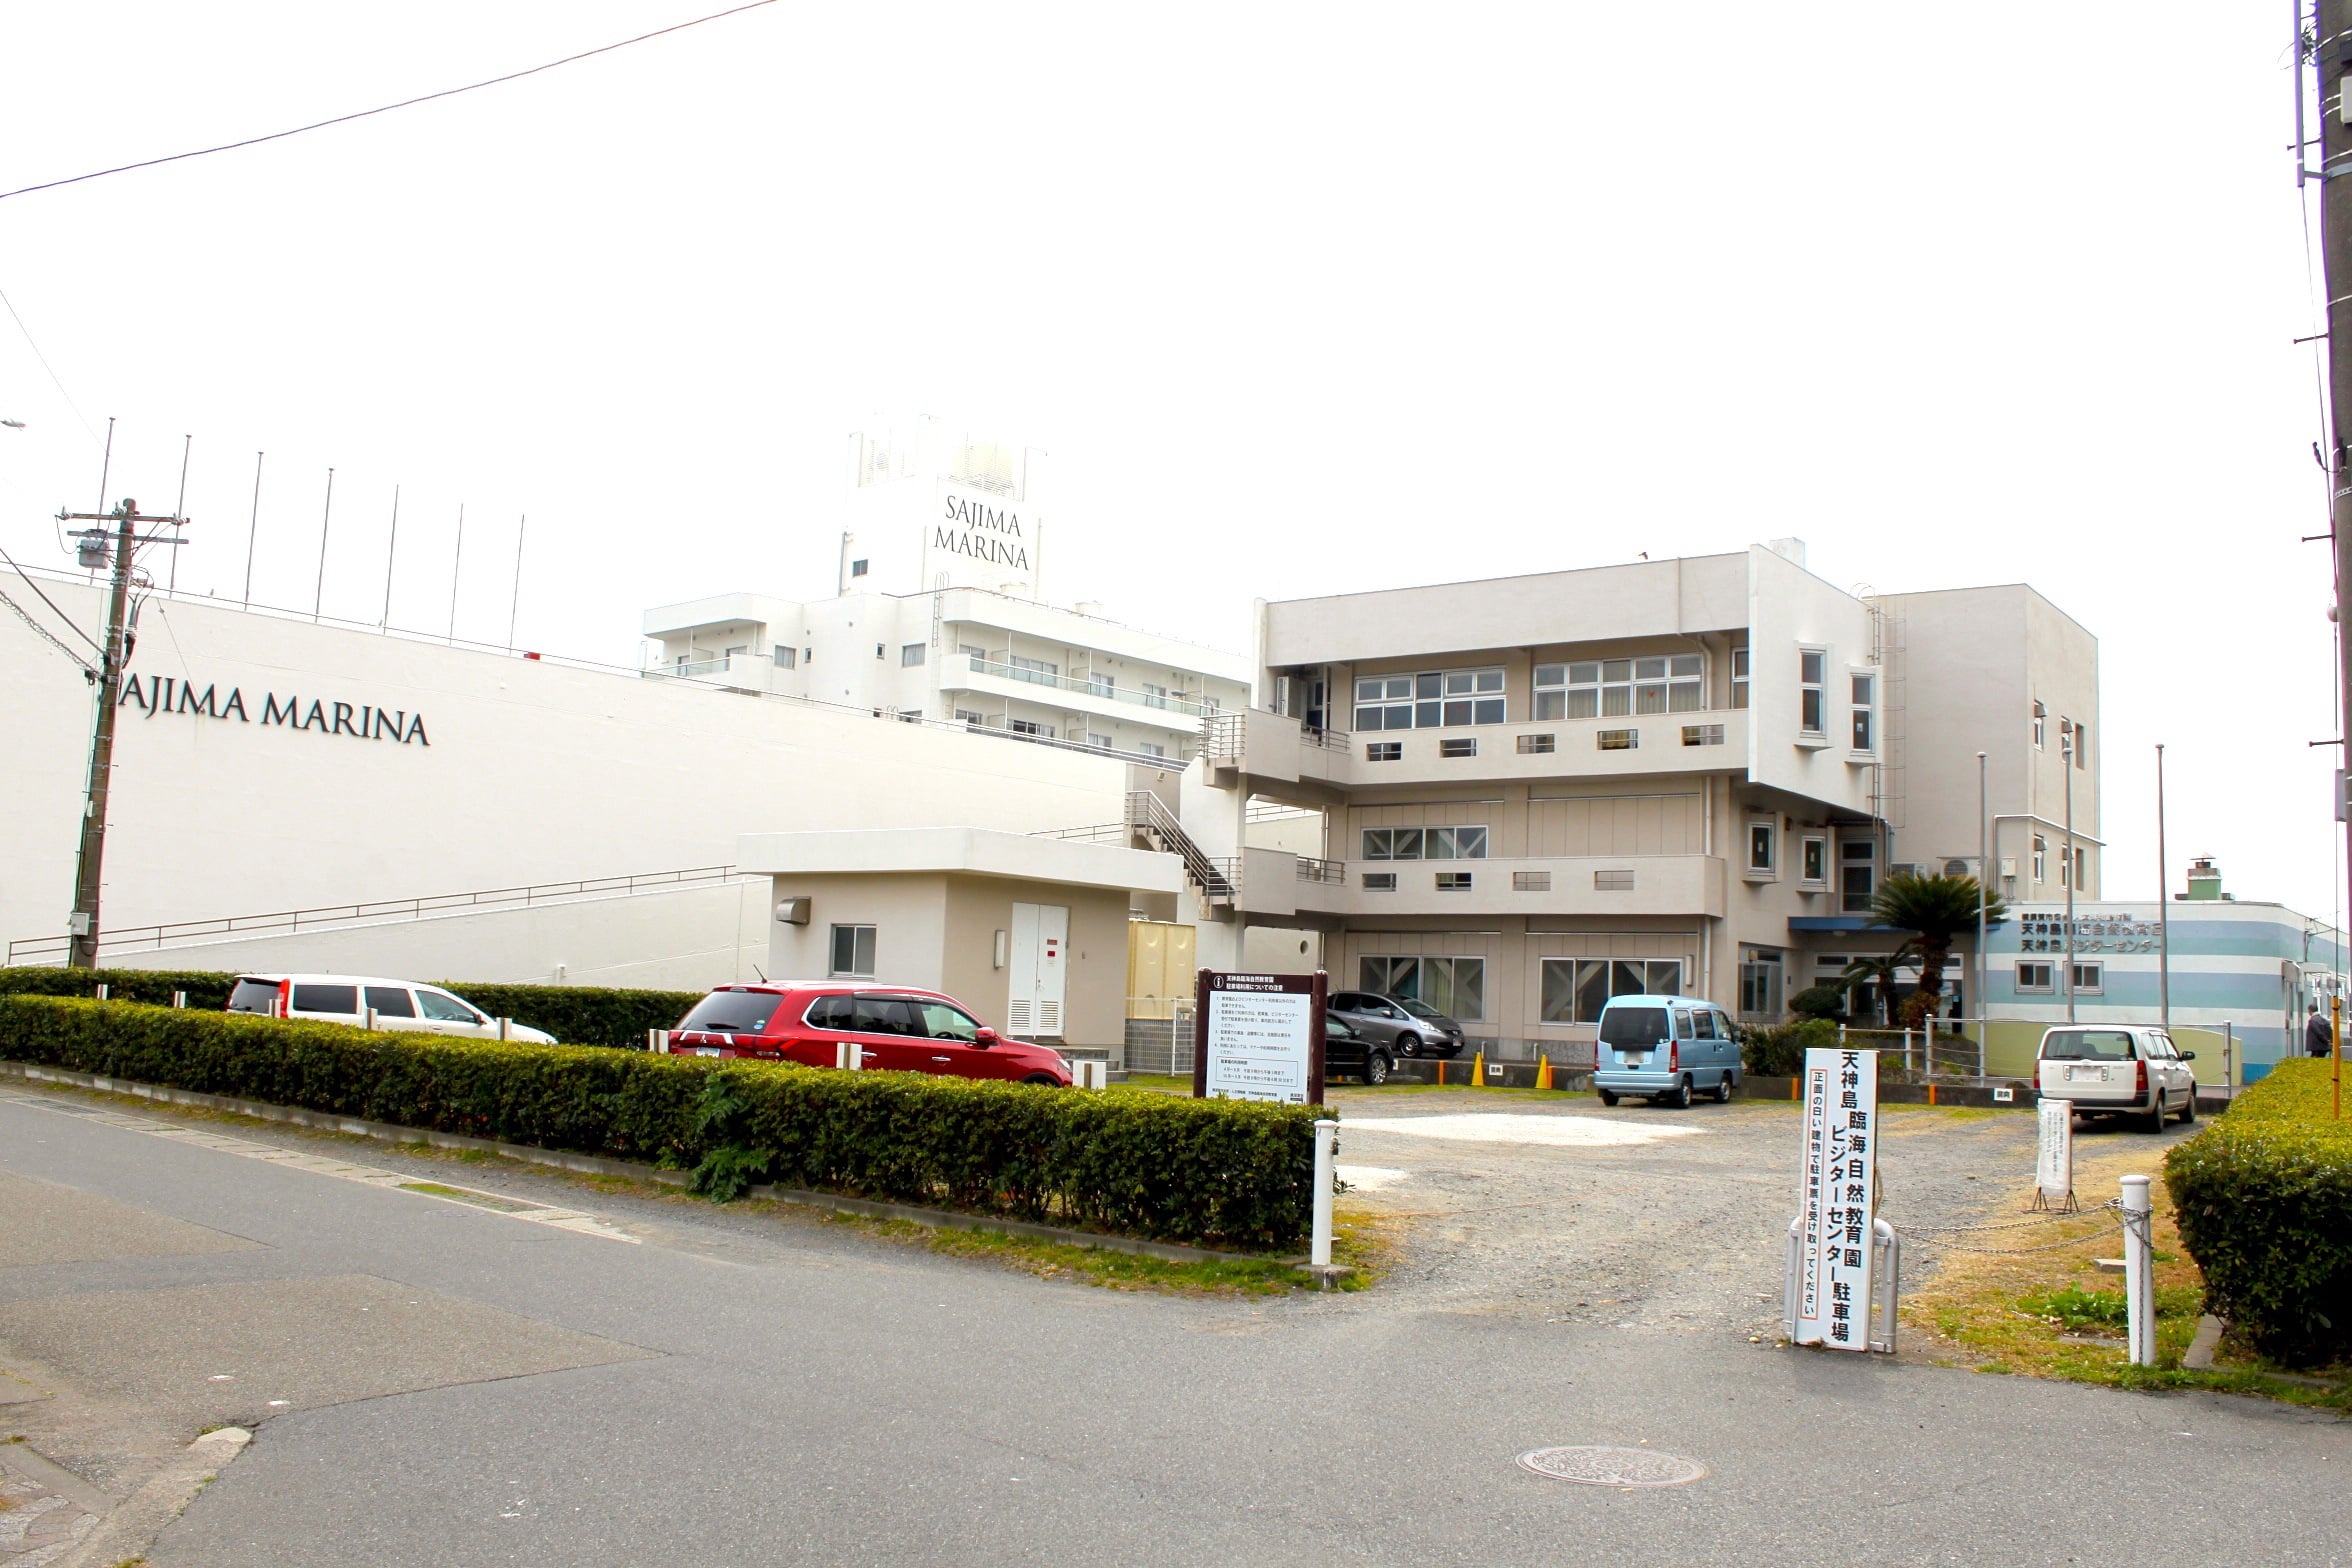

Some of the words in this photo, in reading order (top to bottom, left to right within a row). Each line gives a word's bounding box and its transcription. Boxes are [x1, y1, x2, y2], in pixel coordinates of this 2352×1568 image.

[945, 495, 1021, 537] SAJIMA
[934, 525, 1029, 571] MARINA
[118, 672, 250, 722] AJIMA
[260, 692, 431, 746] MARINA
